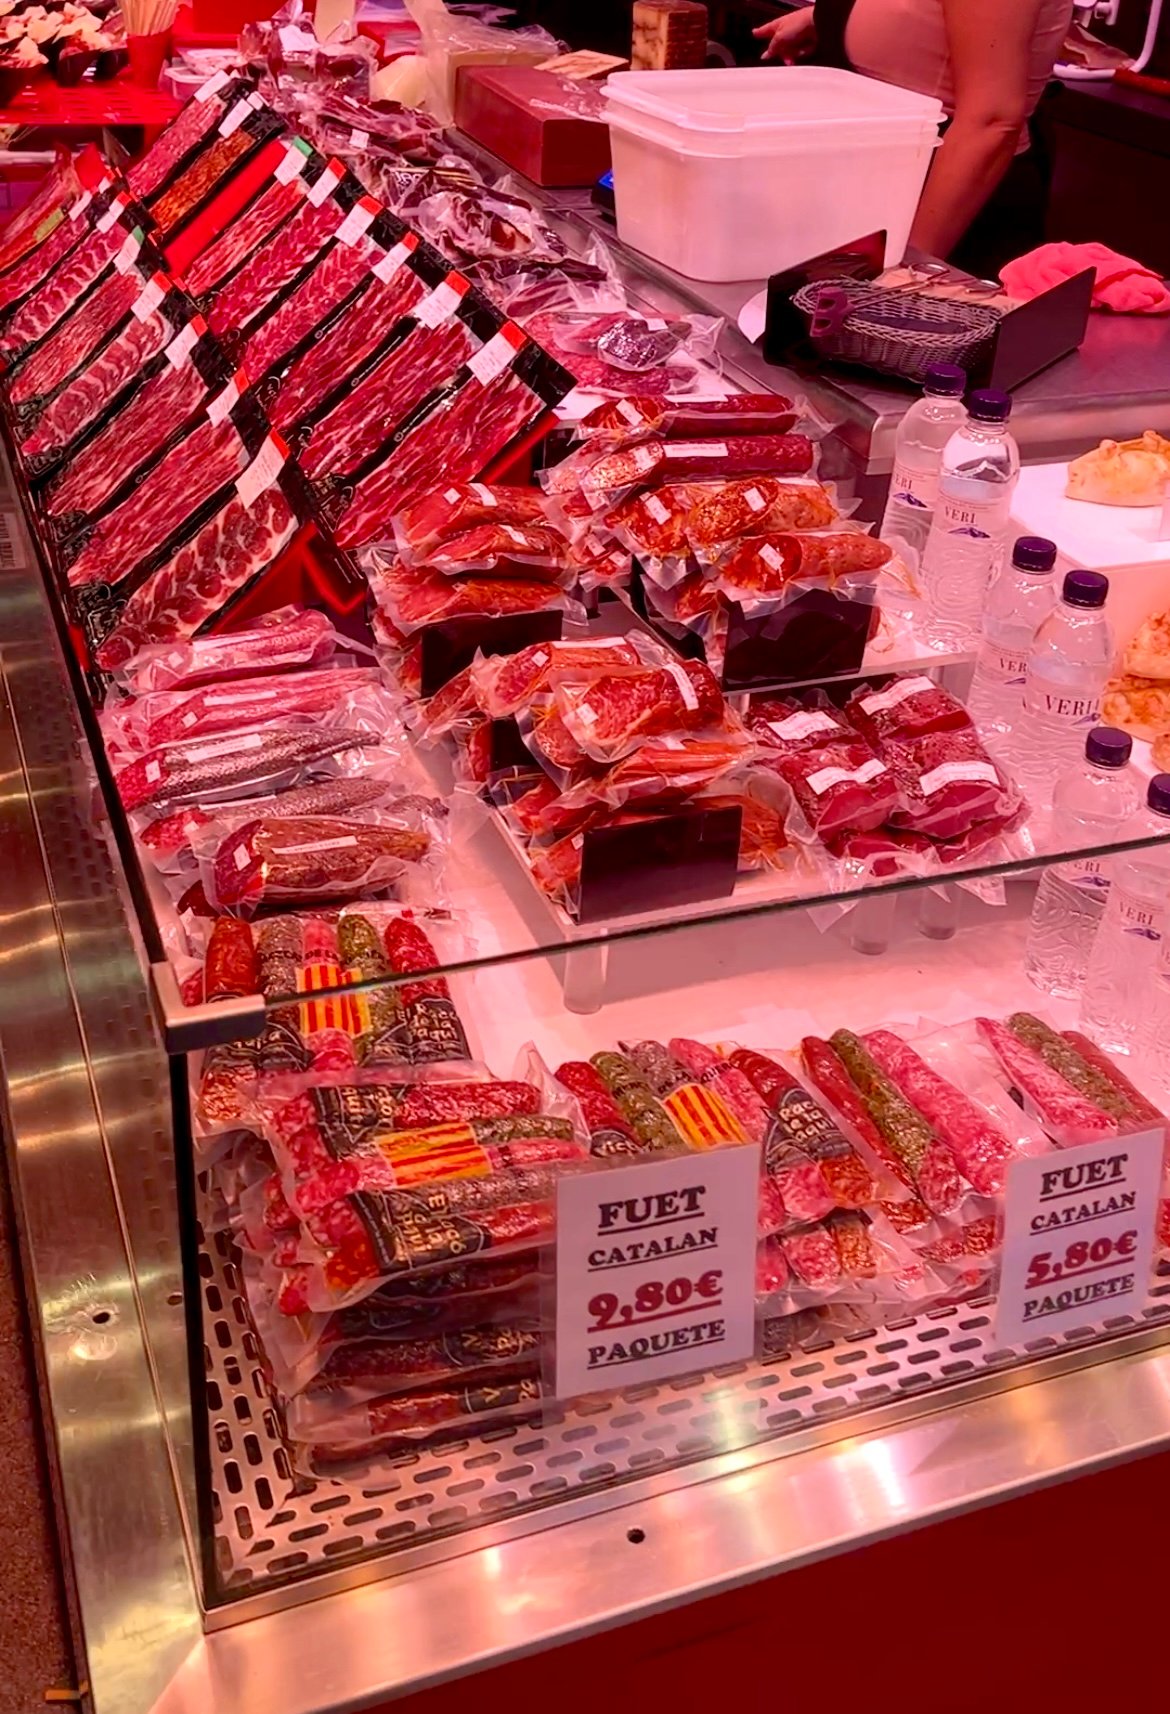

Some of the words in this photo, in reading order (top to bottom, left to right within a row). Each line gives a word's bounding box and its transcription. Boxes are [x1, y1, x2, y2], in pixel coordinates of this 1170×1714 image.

[944, 505, 976, 524] VERI
[1000, 657, 1028, 672] VER
[1046, 694, 1092, 716] VERI
[1040, 1153, 1128, 1196] FUET
[598, 1185, 706, 1228] FUET
[1030, 1191, 1137, 1231] CATALAN
[588, 1227, 719, 1267] CATALAN
[1026, 1229, 1139, 1288] 5,80€
[588, 1270, 724, 1328] 9,80€
[1023, 1273, 1135, 1319] PAQUETE
[588, 1319, 726, 1367] PAQUETE
